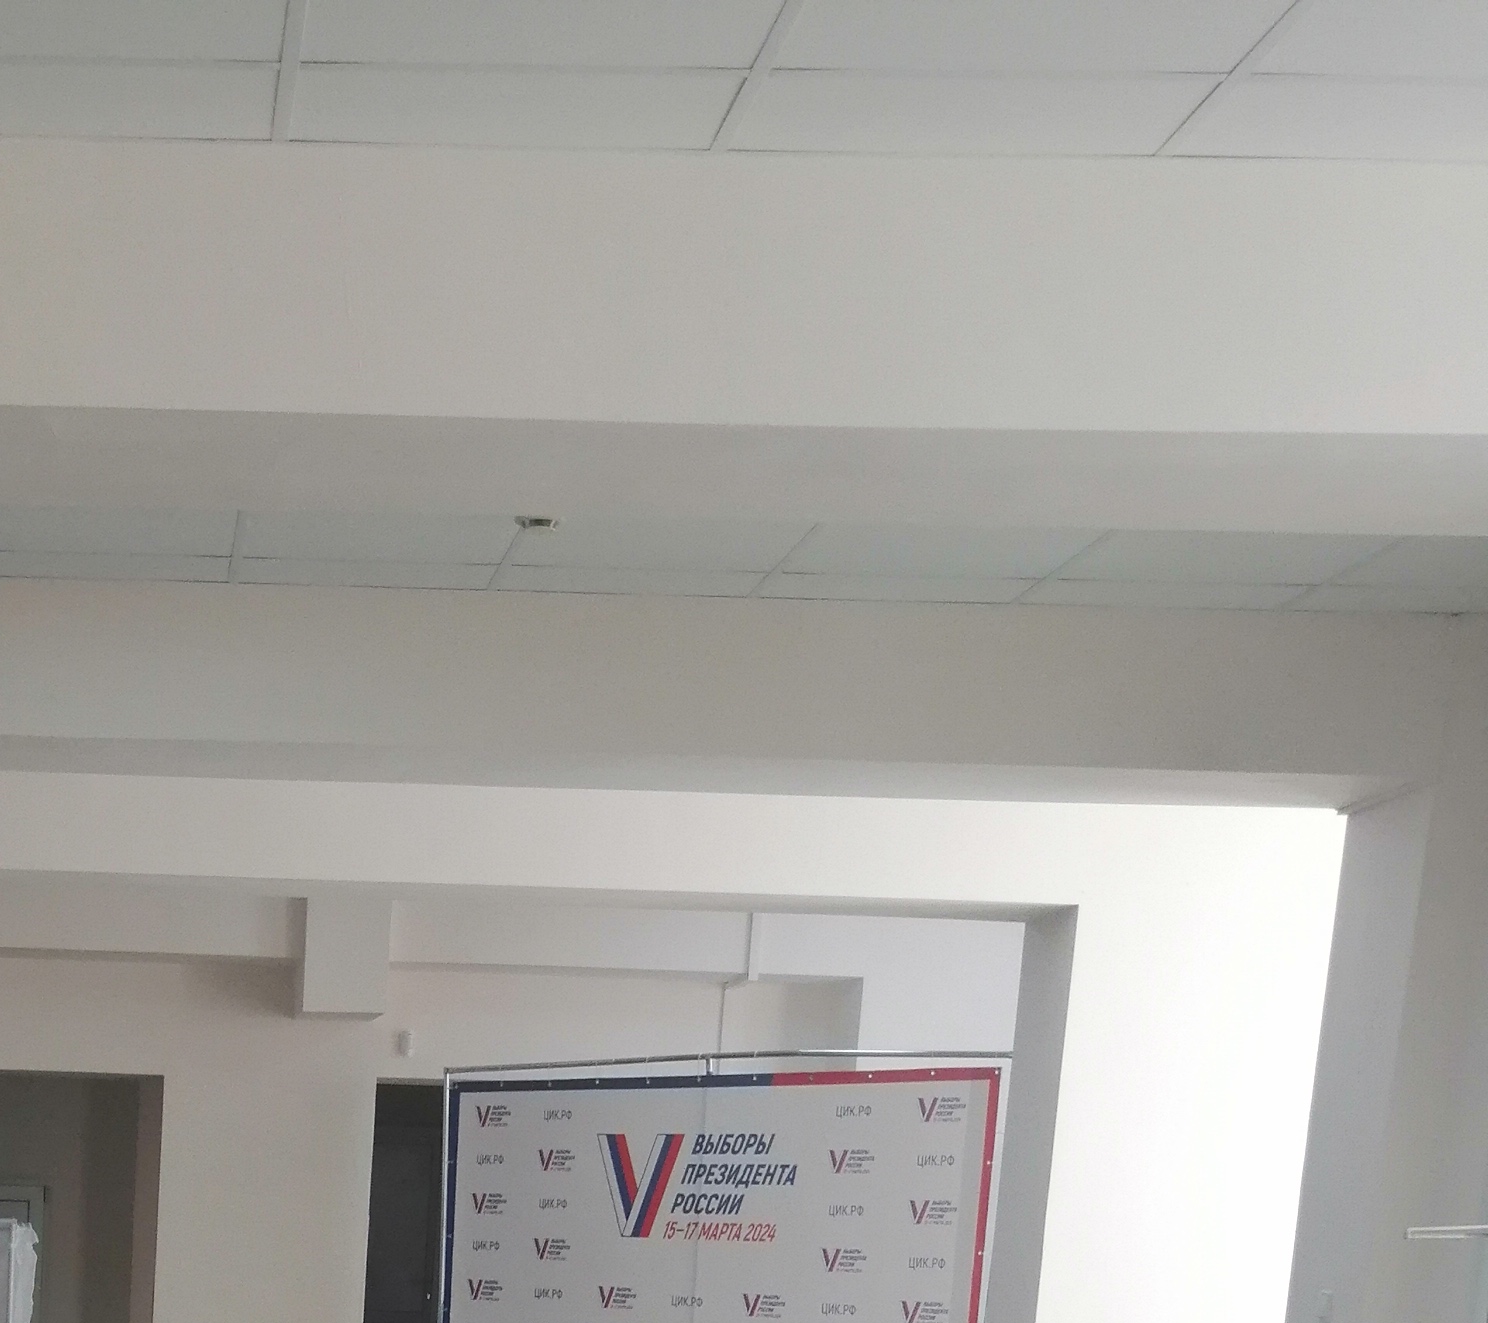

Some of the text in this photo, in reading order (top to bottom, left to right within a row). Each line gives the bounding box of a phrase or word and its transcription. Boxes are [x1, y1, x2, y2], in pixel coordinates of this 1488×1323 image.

[691, 1133, 775, 1155] ВЫБОРЫ
[681, 1163, 798, 1188] ПРЕЗИДЕНТА
[671, 1193, 745, 1215] РОССИИ
[699, 1222, 742, 1241] МАРТА
[743, 1223, 777, 1242] 2024
